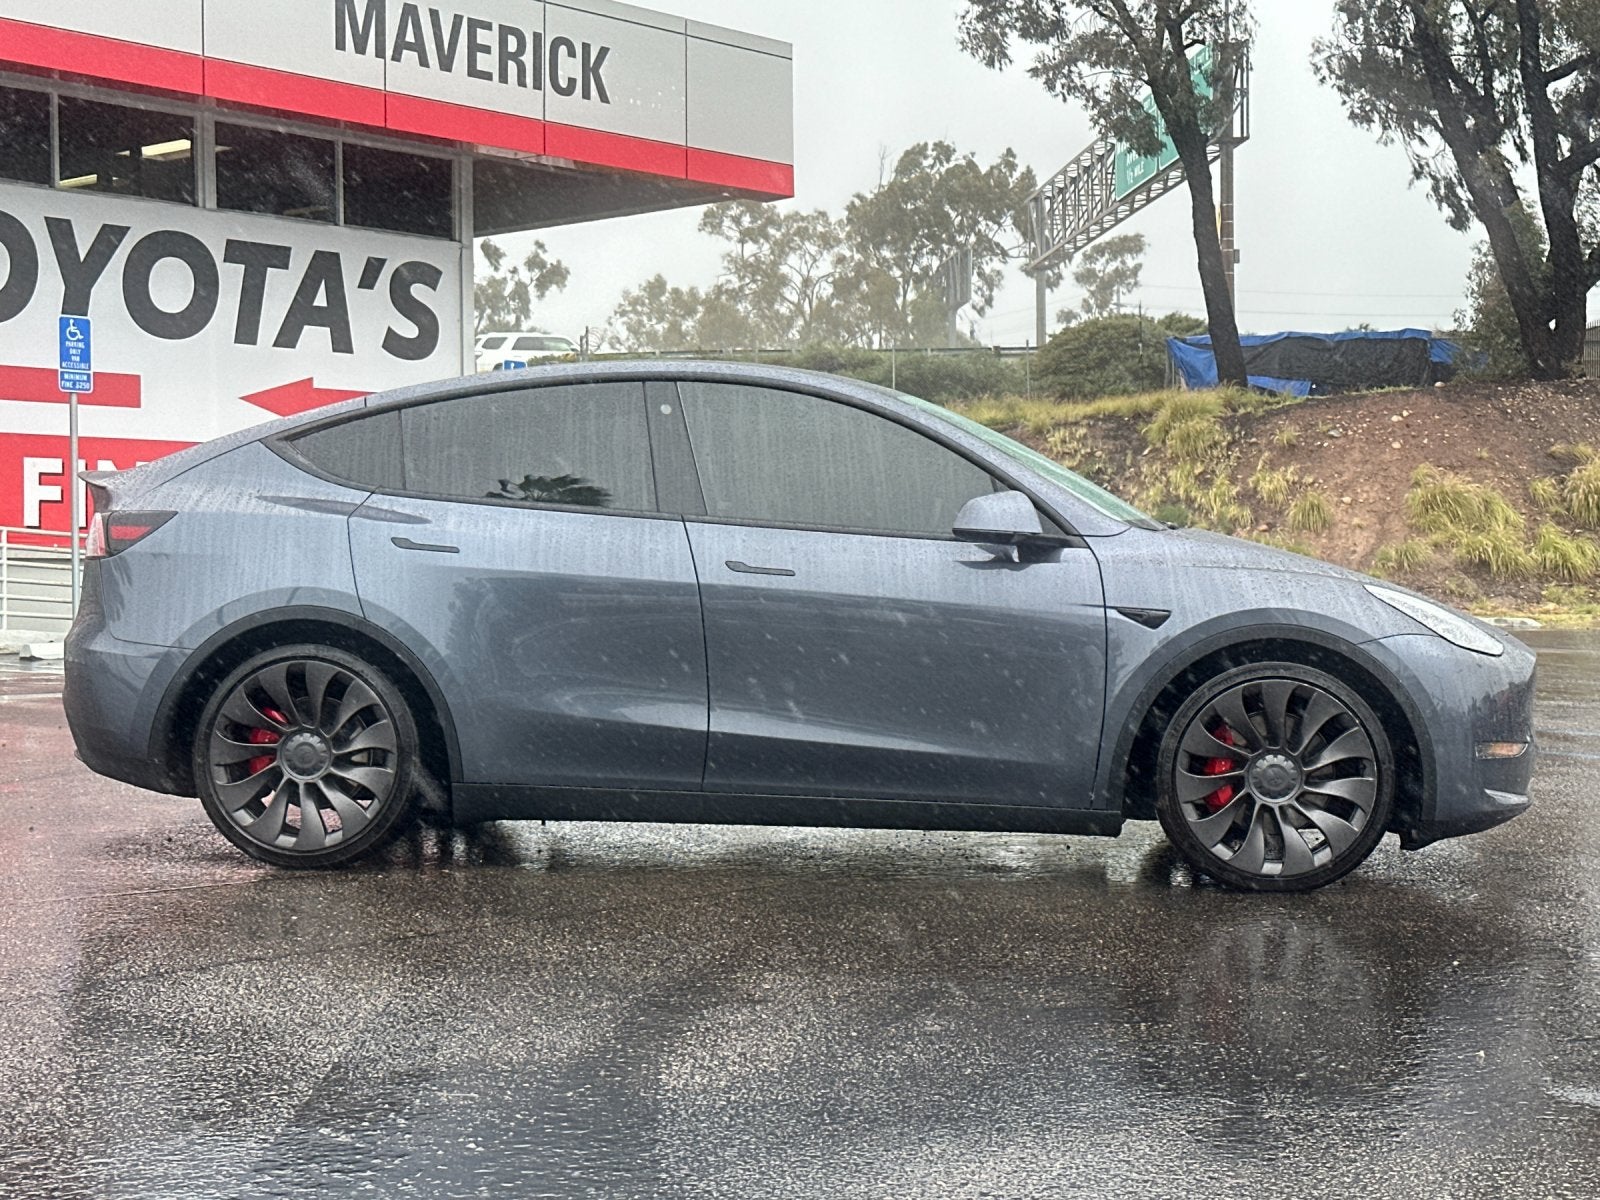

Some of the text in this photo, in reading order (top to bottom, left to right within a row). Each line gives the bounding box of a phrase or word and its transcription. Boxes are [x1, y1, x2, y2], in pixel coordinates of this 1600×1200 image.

[335, 0, 611, 104] MAVERICK
[65, 341, 85, 349] PARKING
[62, 361, 89, 369] ACCESSIBLE
[64, 373, 87, 381] MINIMUM
